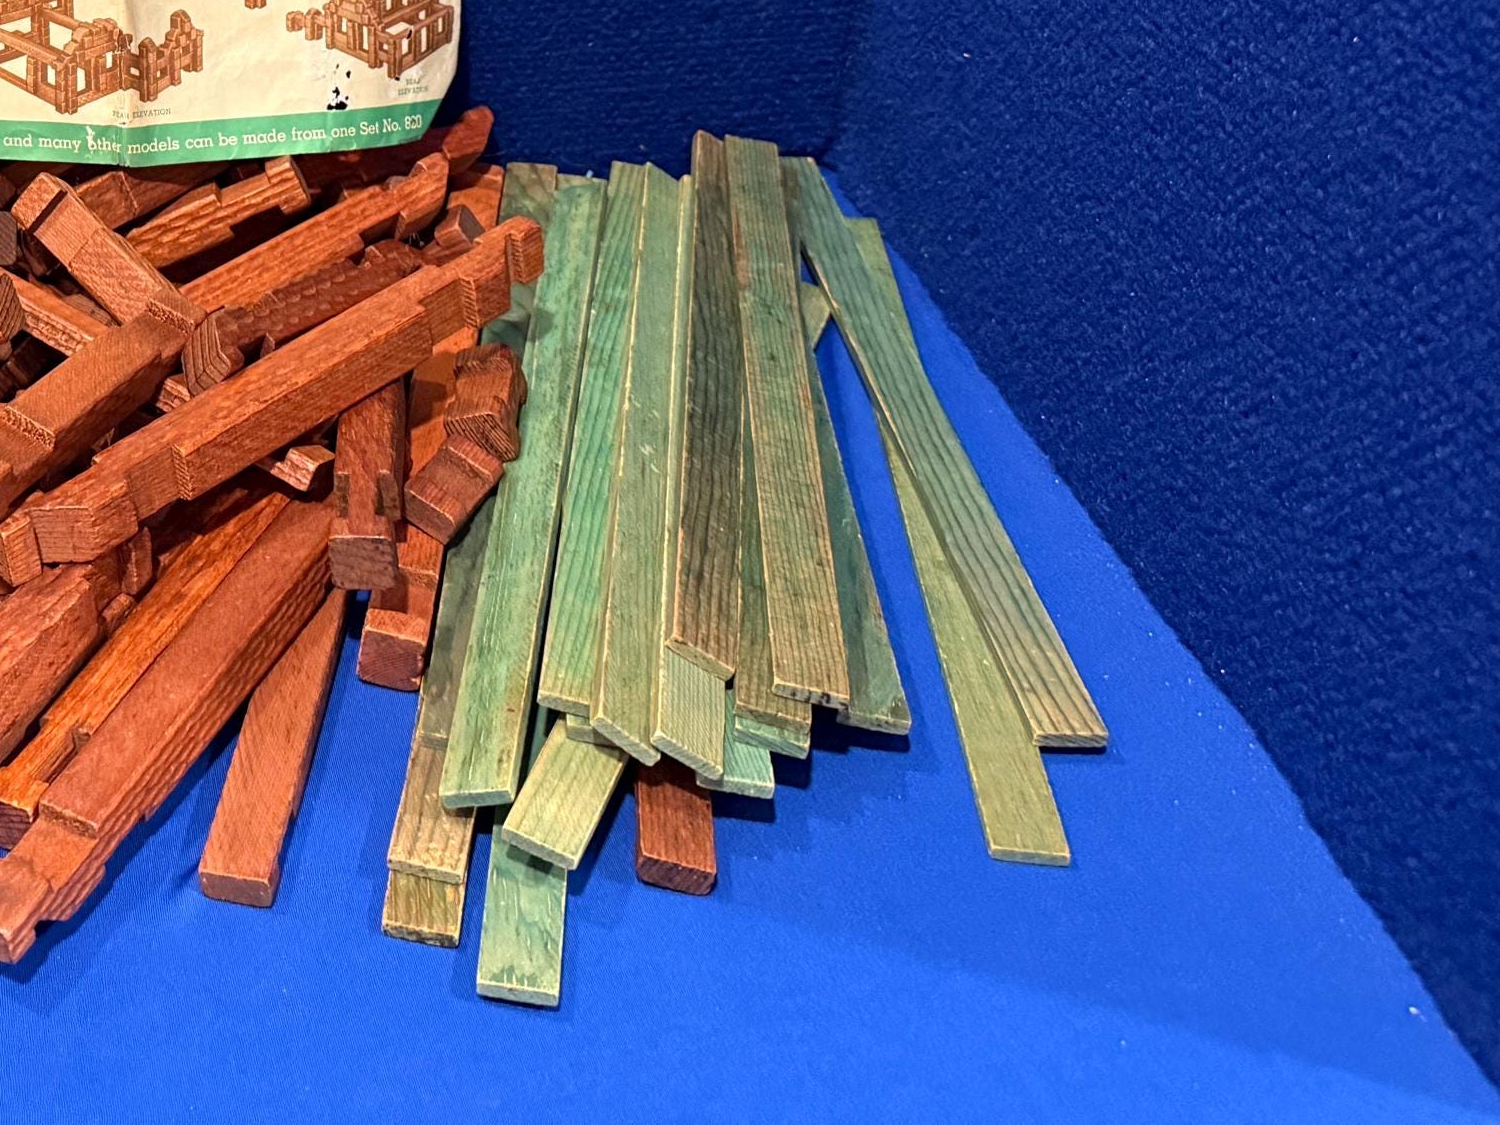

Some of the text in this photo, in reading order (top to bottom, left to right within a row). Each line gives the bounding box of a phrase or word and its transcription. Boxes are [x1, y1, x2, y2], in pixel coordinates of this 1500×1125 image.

[132, 107, 171, 119] ELEVATION
[3, 133, 33, 148] and
[38, 137, 82, 153] many
[89, 136, 122, 153] other
[127, 133, 180, 155] models
[185, 136, 214, 150] can
[218, 132, 238, 147] be
[243, 128, 286, 146] made
[291, 126, 327, 141] from
[331, 126, 356, 138] one
[360, 120, 380, 135] Set
[382, 117, 402, 133] No.
